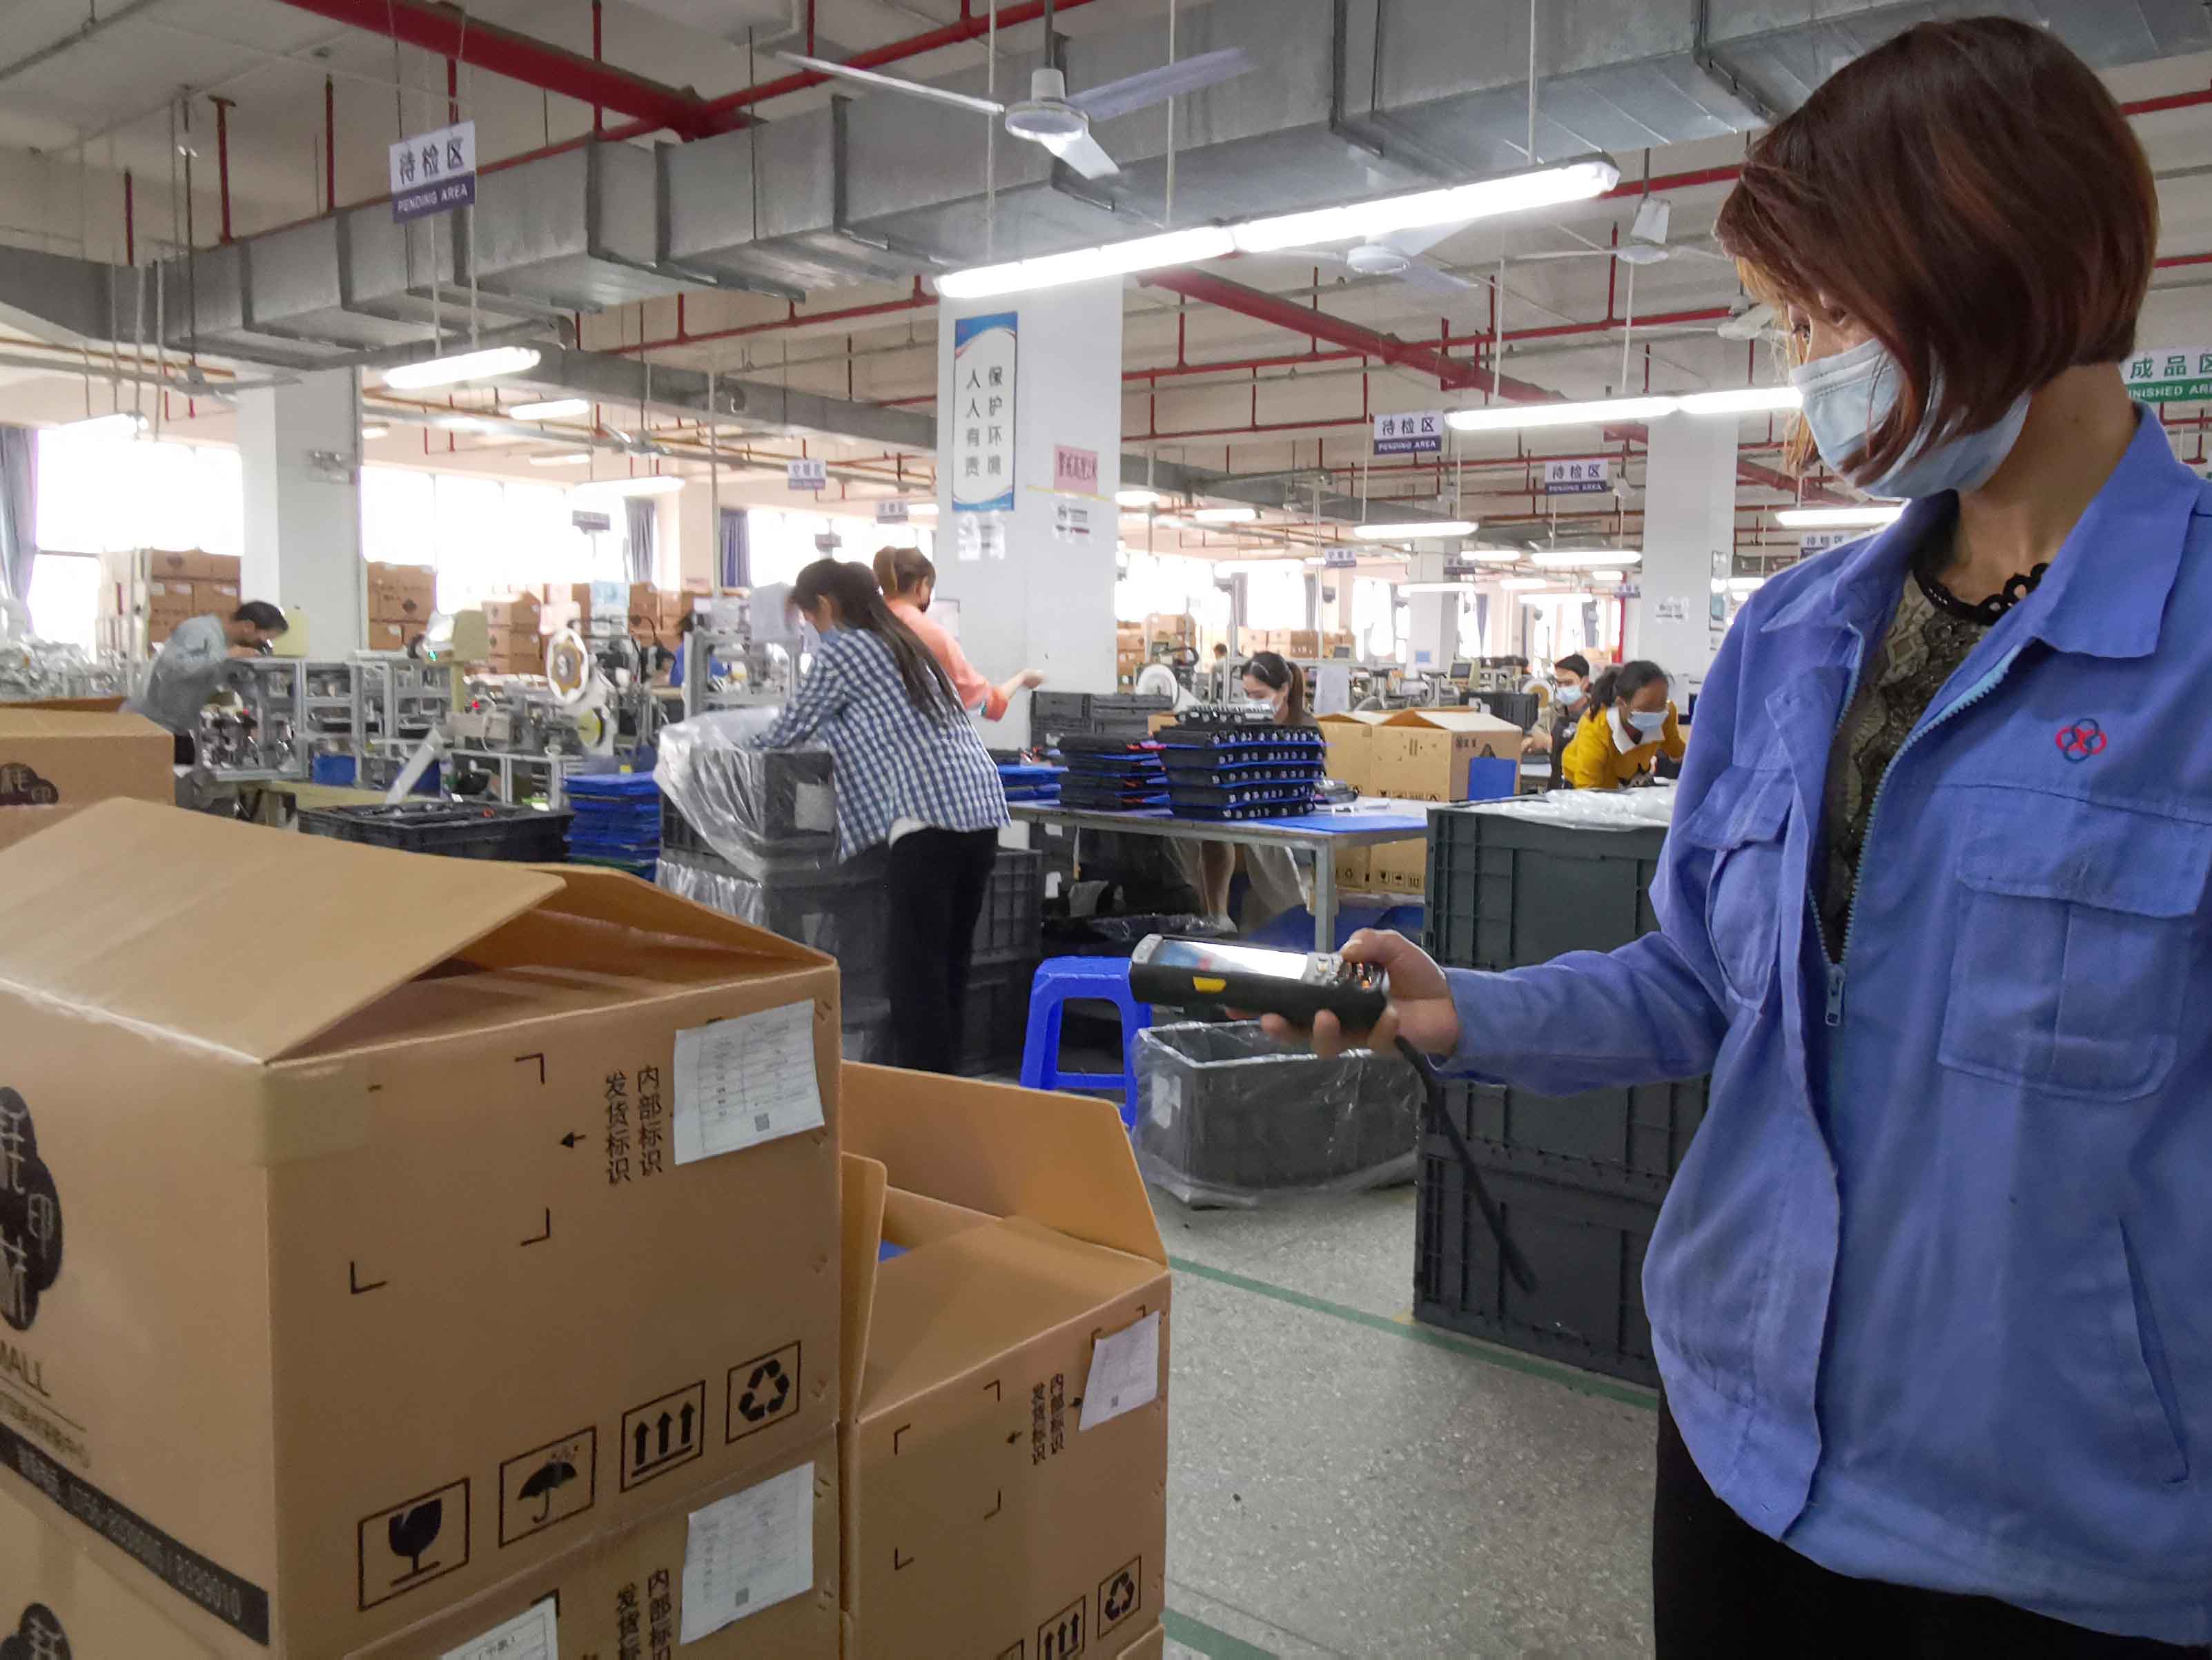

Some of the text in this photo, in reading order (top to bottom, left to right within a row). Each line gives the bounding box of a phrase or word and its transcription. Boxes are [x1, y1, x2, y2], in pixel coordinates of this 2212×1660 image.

[400, 137, 464, 184] 待检区
[398, 183, 468, 212] PENDING AREA
[2130, 353, 2212, 379] 成品区
[2128, 383, 2212, 398] INISHED AR
[966, 368, 981, 477] 人人有责
[988, 365, 1003, 476] 保护环境
[1382, 416, 1434, 436] 待检区
[1378, 440, 1436, 451] PENDING AREA
[1553, 463, 1600, 480] 待检区
[605, 1068, 631, 1185] 发货标识
[638, 1064, 663, 1176] 内部标识
